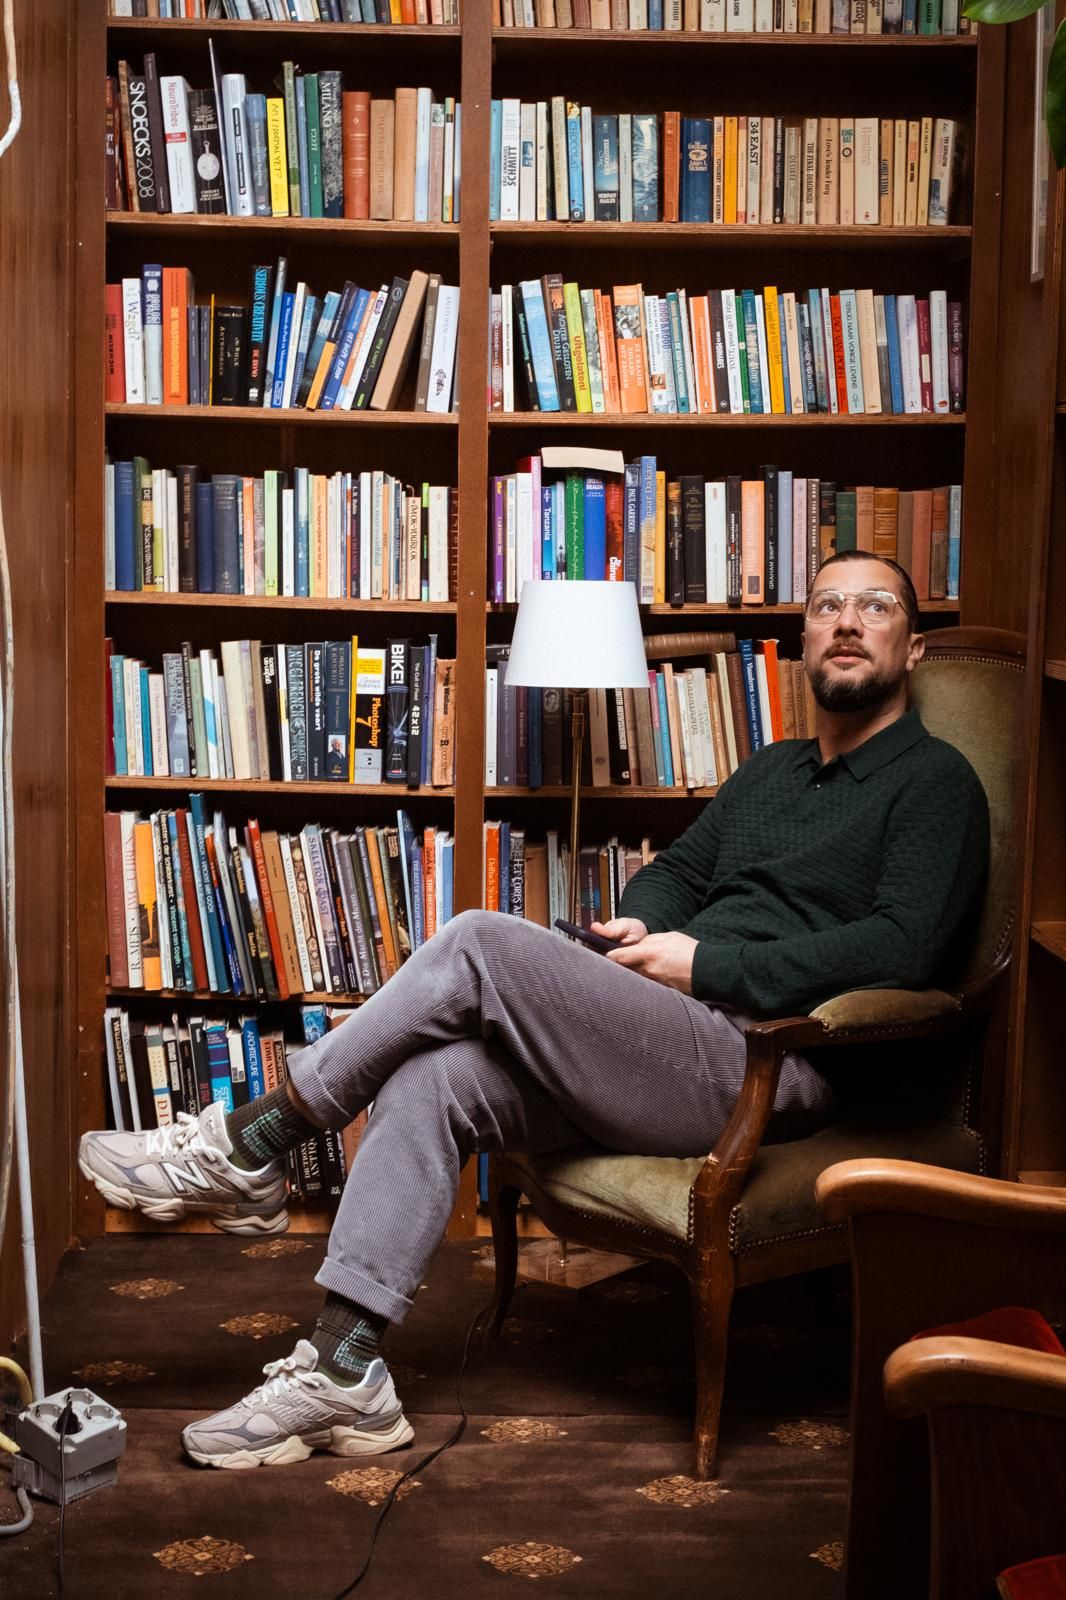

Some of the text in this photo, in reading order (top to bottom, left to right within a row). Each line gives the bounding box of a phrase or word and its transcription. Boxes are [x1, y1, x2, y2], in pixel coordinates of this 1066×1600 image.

[168, 82, 180, 127] NeuroTribes
[321, 81, 334, 128] MILANO
[130, 81, 156, 198] SNOECKS 2008
[310, 128, 319, 151] LUCCA
[569, 121, 580, 170] CHOCOLAT
[750, 121, 759, 167] 34 EAST
[825, 139, 833, 158] Love's
[507, 145, 517, 187] SCHMITT
[806, 142, 815, 204] THE FINAL DIAGNOSIS
[253, 268, 268, 301] SERIOUS
[251, 301, 265, 343] CREATIVITY
[552, 329, 563, 361] DEUREN
[558, 313, 573, 380] ACHTER GESLOTEN
[573, 335, 588, 391] Uitgelaten!
[143, 489, 151, 500] DE
[644, 464, 655, 494] Dakar
[543, 507, 552, 541] Tanzania
[627, 488, 637, 533] PAUL GARRISON
[314, 649, 321, 659] De
[391, 643, 405, 685] BIKE!
[288, 650, 305, 717] NICCI FRENCH
[314, 661, 322, 683] grote
[746, 662, 755, 693] Vlaanderen
[356, 716, 371, 727] 7
[369, 697, 381, 747] Photoshop
[411, 705, 420, 736] 42x12
[159, 814, 169, 841] Meesters
[163, 844, 171, 855] der
[513, 858, 524, 875] HET
[163, 857, 175, 898] Schilderkunst
[308, 837, 330, 917] SKELETON COAST
[511, 876, 523, 904] CORPS
[488, 886, 496, 912] Studen
[169, 906, 178, 932] Vincent
[172, 947, 181, 964] Gogh
[350, 894, 371, 986] Die Macht der Musen
[246, 1030, 258, 1077] ARCHITECTURE
[300, 1142, 312, 1179] DICTIONA
[325, 1137, 335, 1162] LUCHT
[158, 1160, 217, 1196] N
